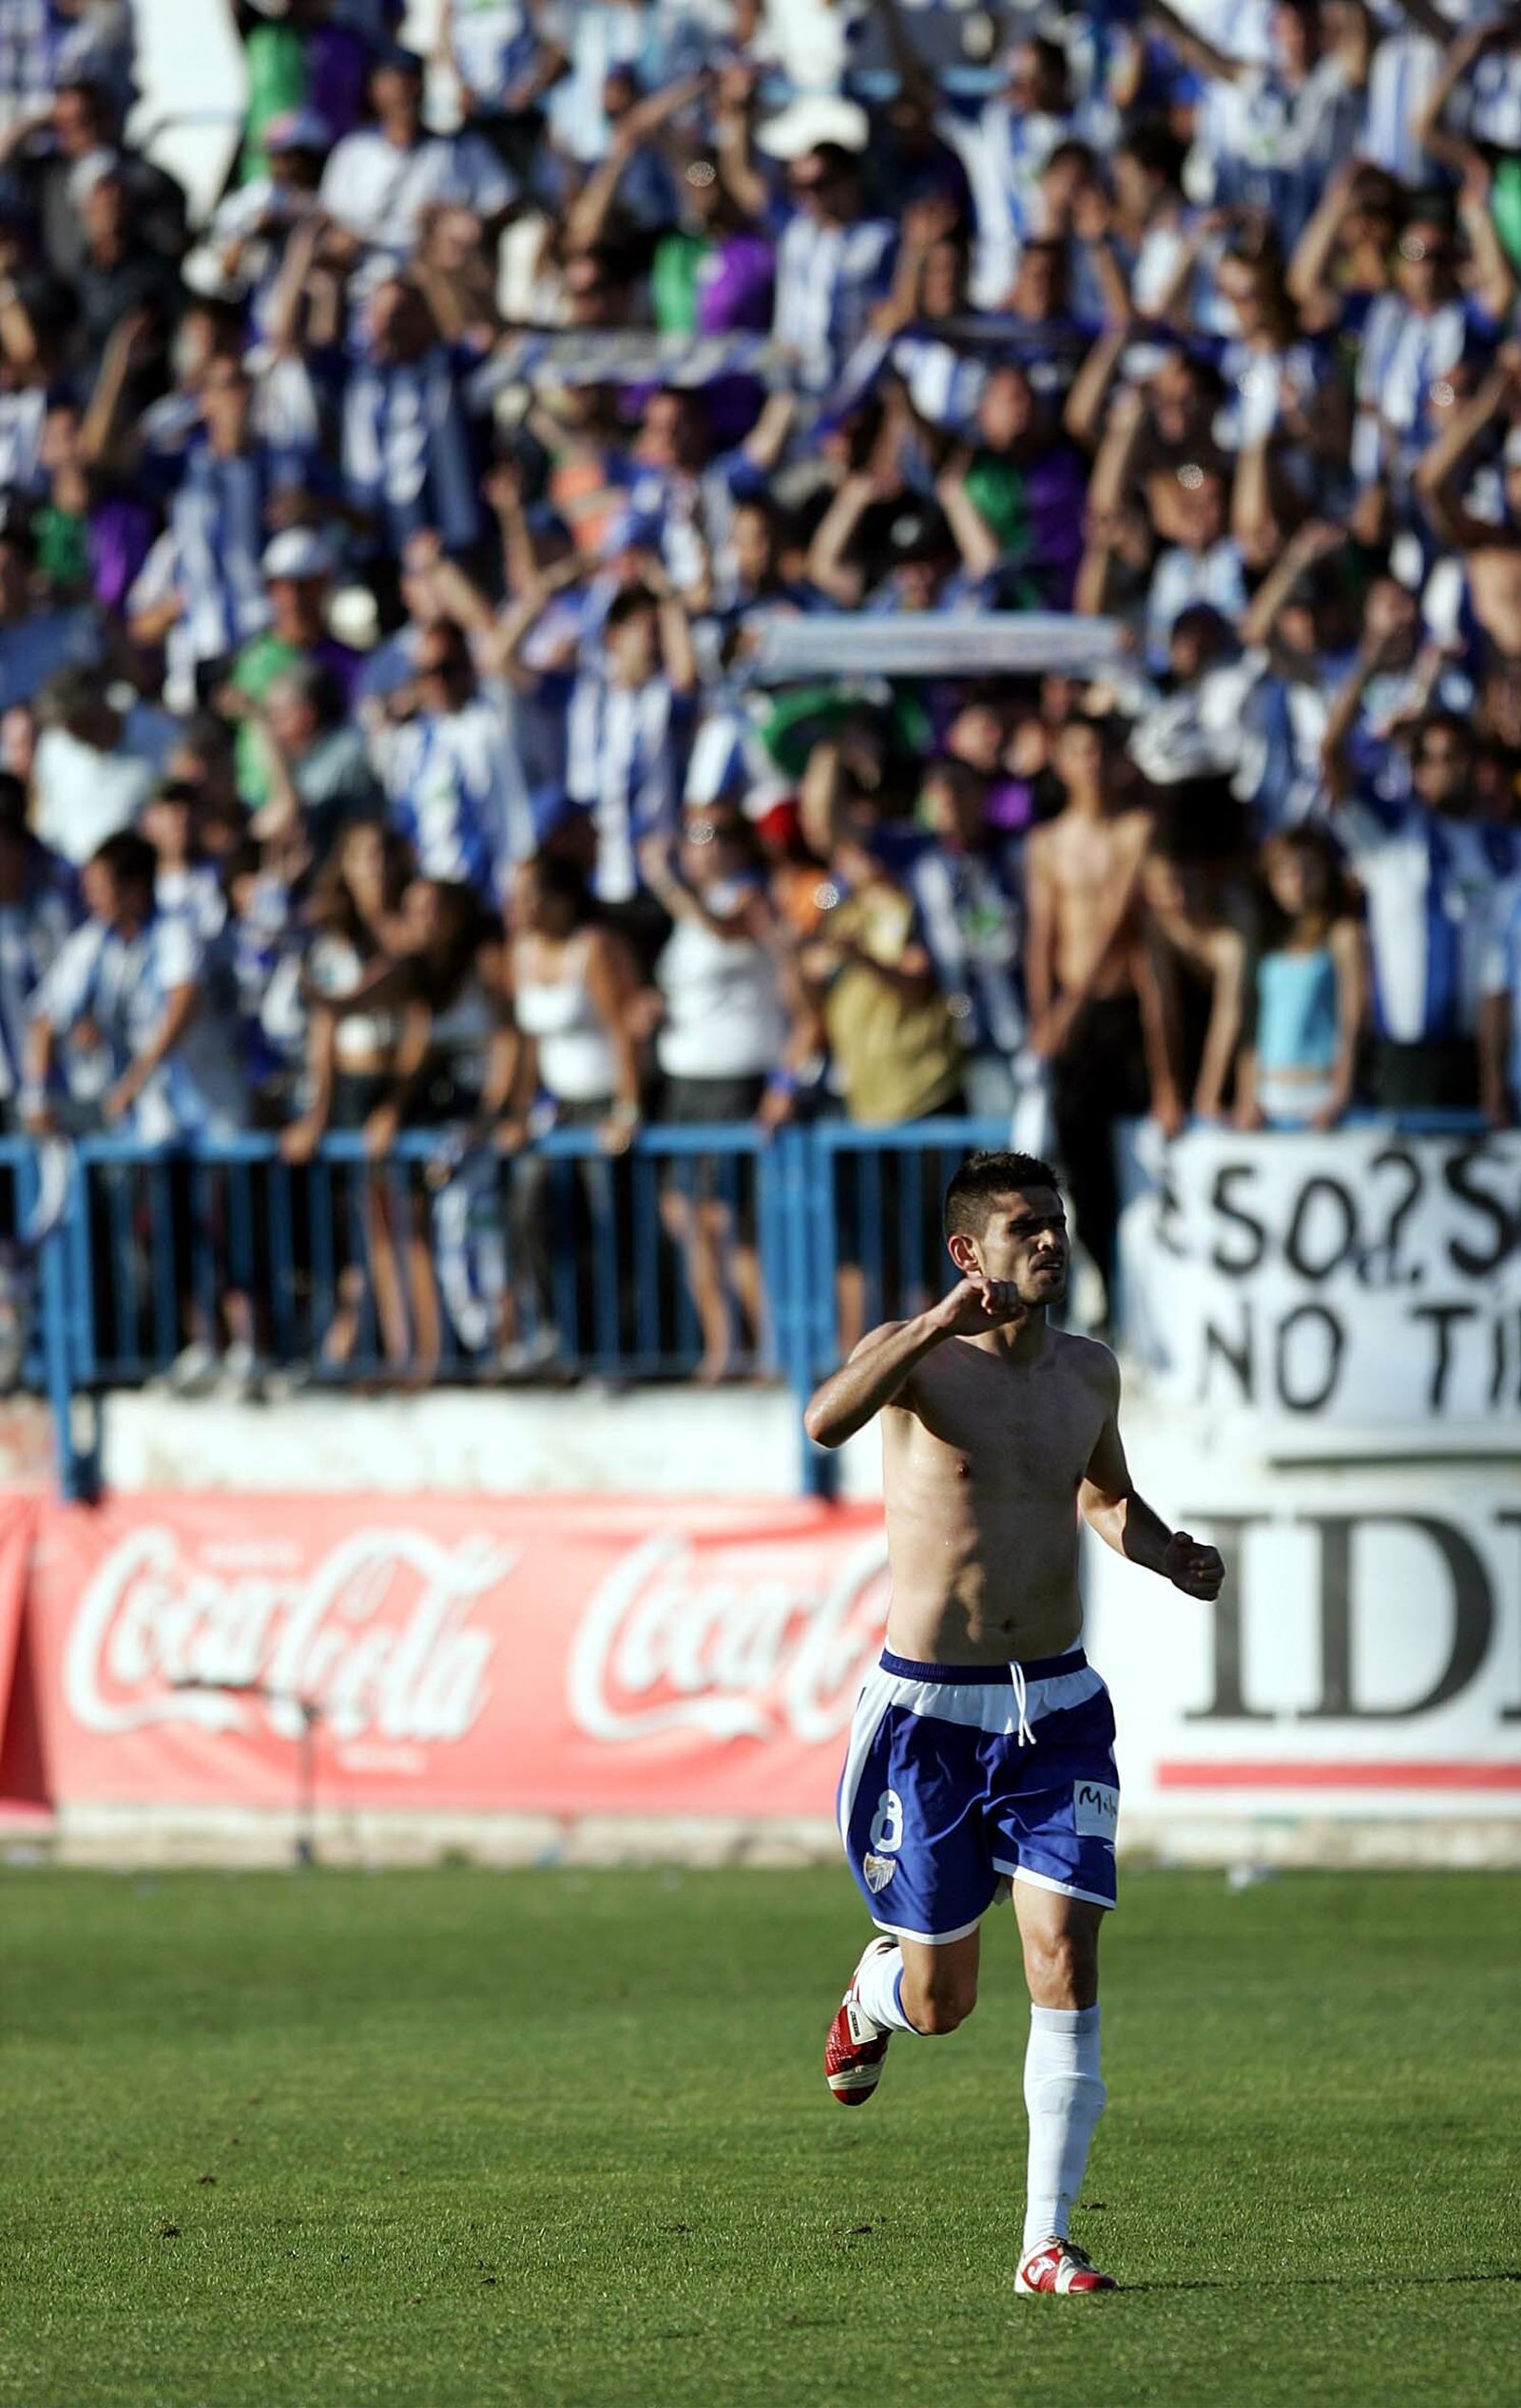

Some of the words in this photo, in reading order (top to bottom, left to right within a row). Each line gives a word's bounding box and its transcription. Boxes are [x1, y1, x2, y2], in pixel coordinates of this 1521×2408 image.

[1200, 1302, 1344, 1414] NO
[1411, 1302, 1521, 1414] TI
[65, 1527, 521, 1742] Coca-Cola
[1183, 1510, 1521, 1723] ID
[870, 1788, 903, 1853] 8
